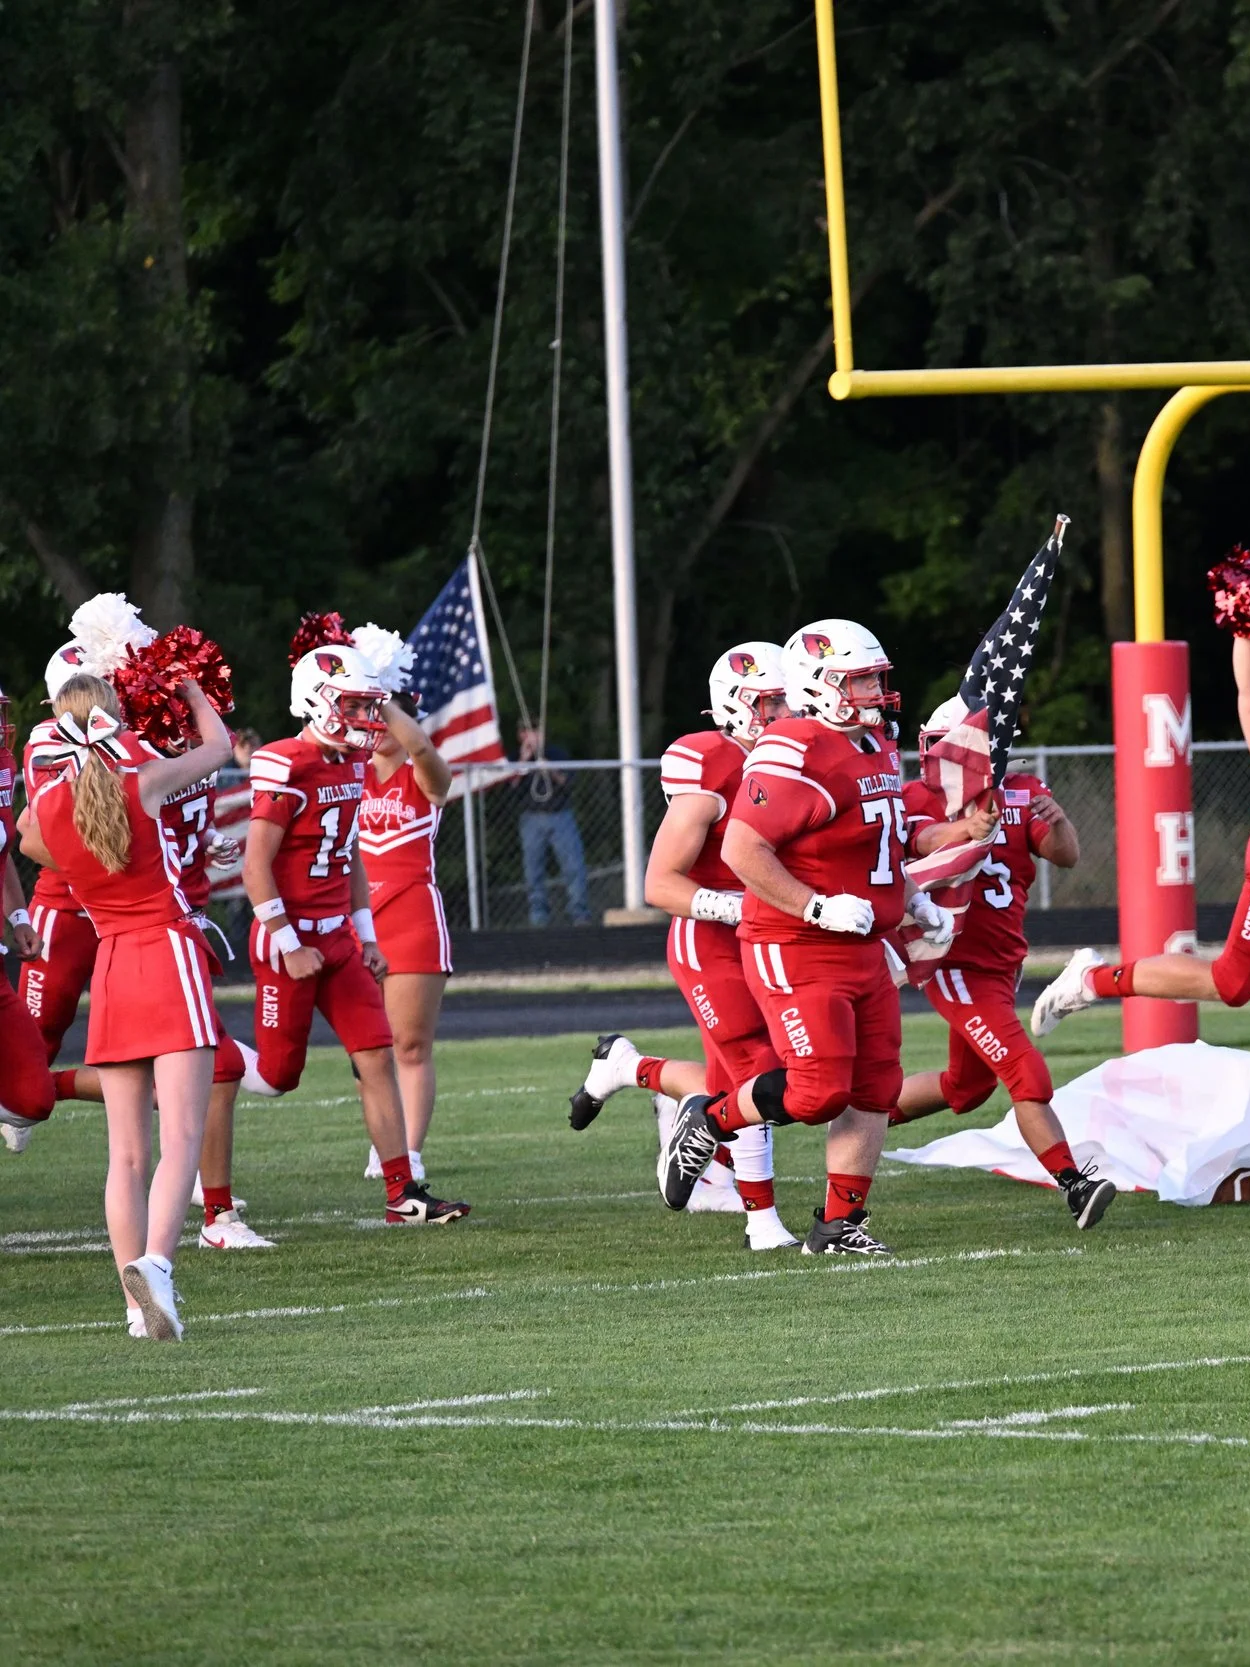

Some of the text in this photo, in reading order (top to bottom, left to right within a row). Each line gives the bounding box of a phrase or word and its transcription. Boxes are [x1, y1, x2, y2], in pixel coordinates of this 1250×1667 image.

[26, 969, 45, 1018] CARDS
[262, 985, 279, 1028] CARDS
[691, 984, 719, 1030] CARDS
[780, 1007, 813, 1058] CARDS
[964, 1015, 1009, 1063] CARDS
